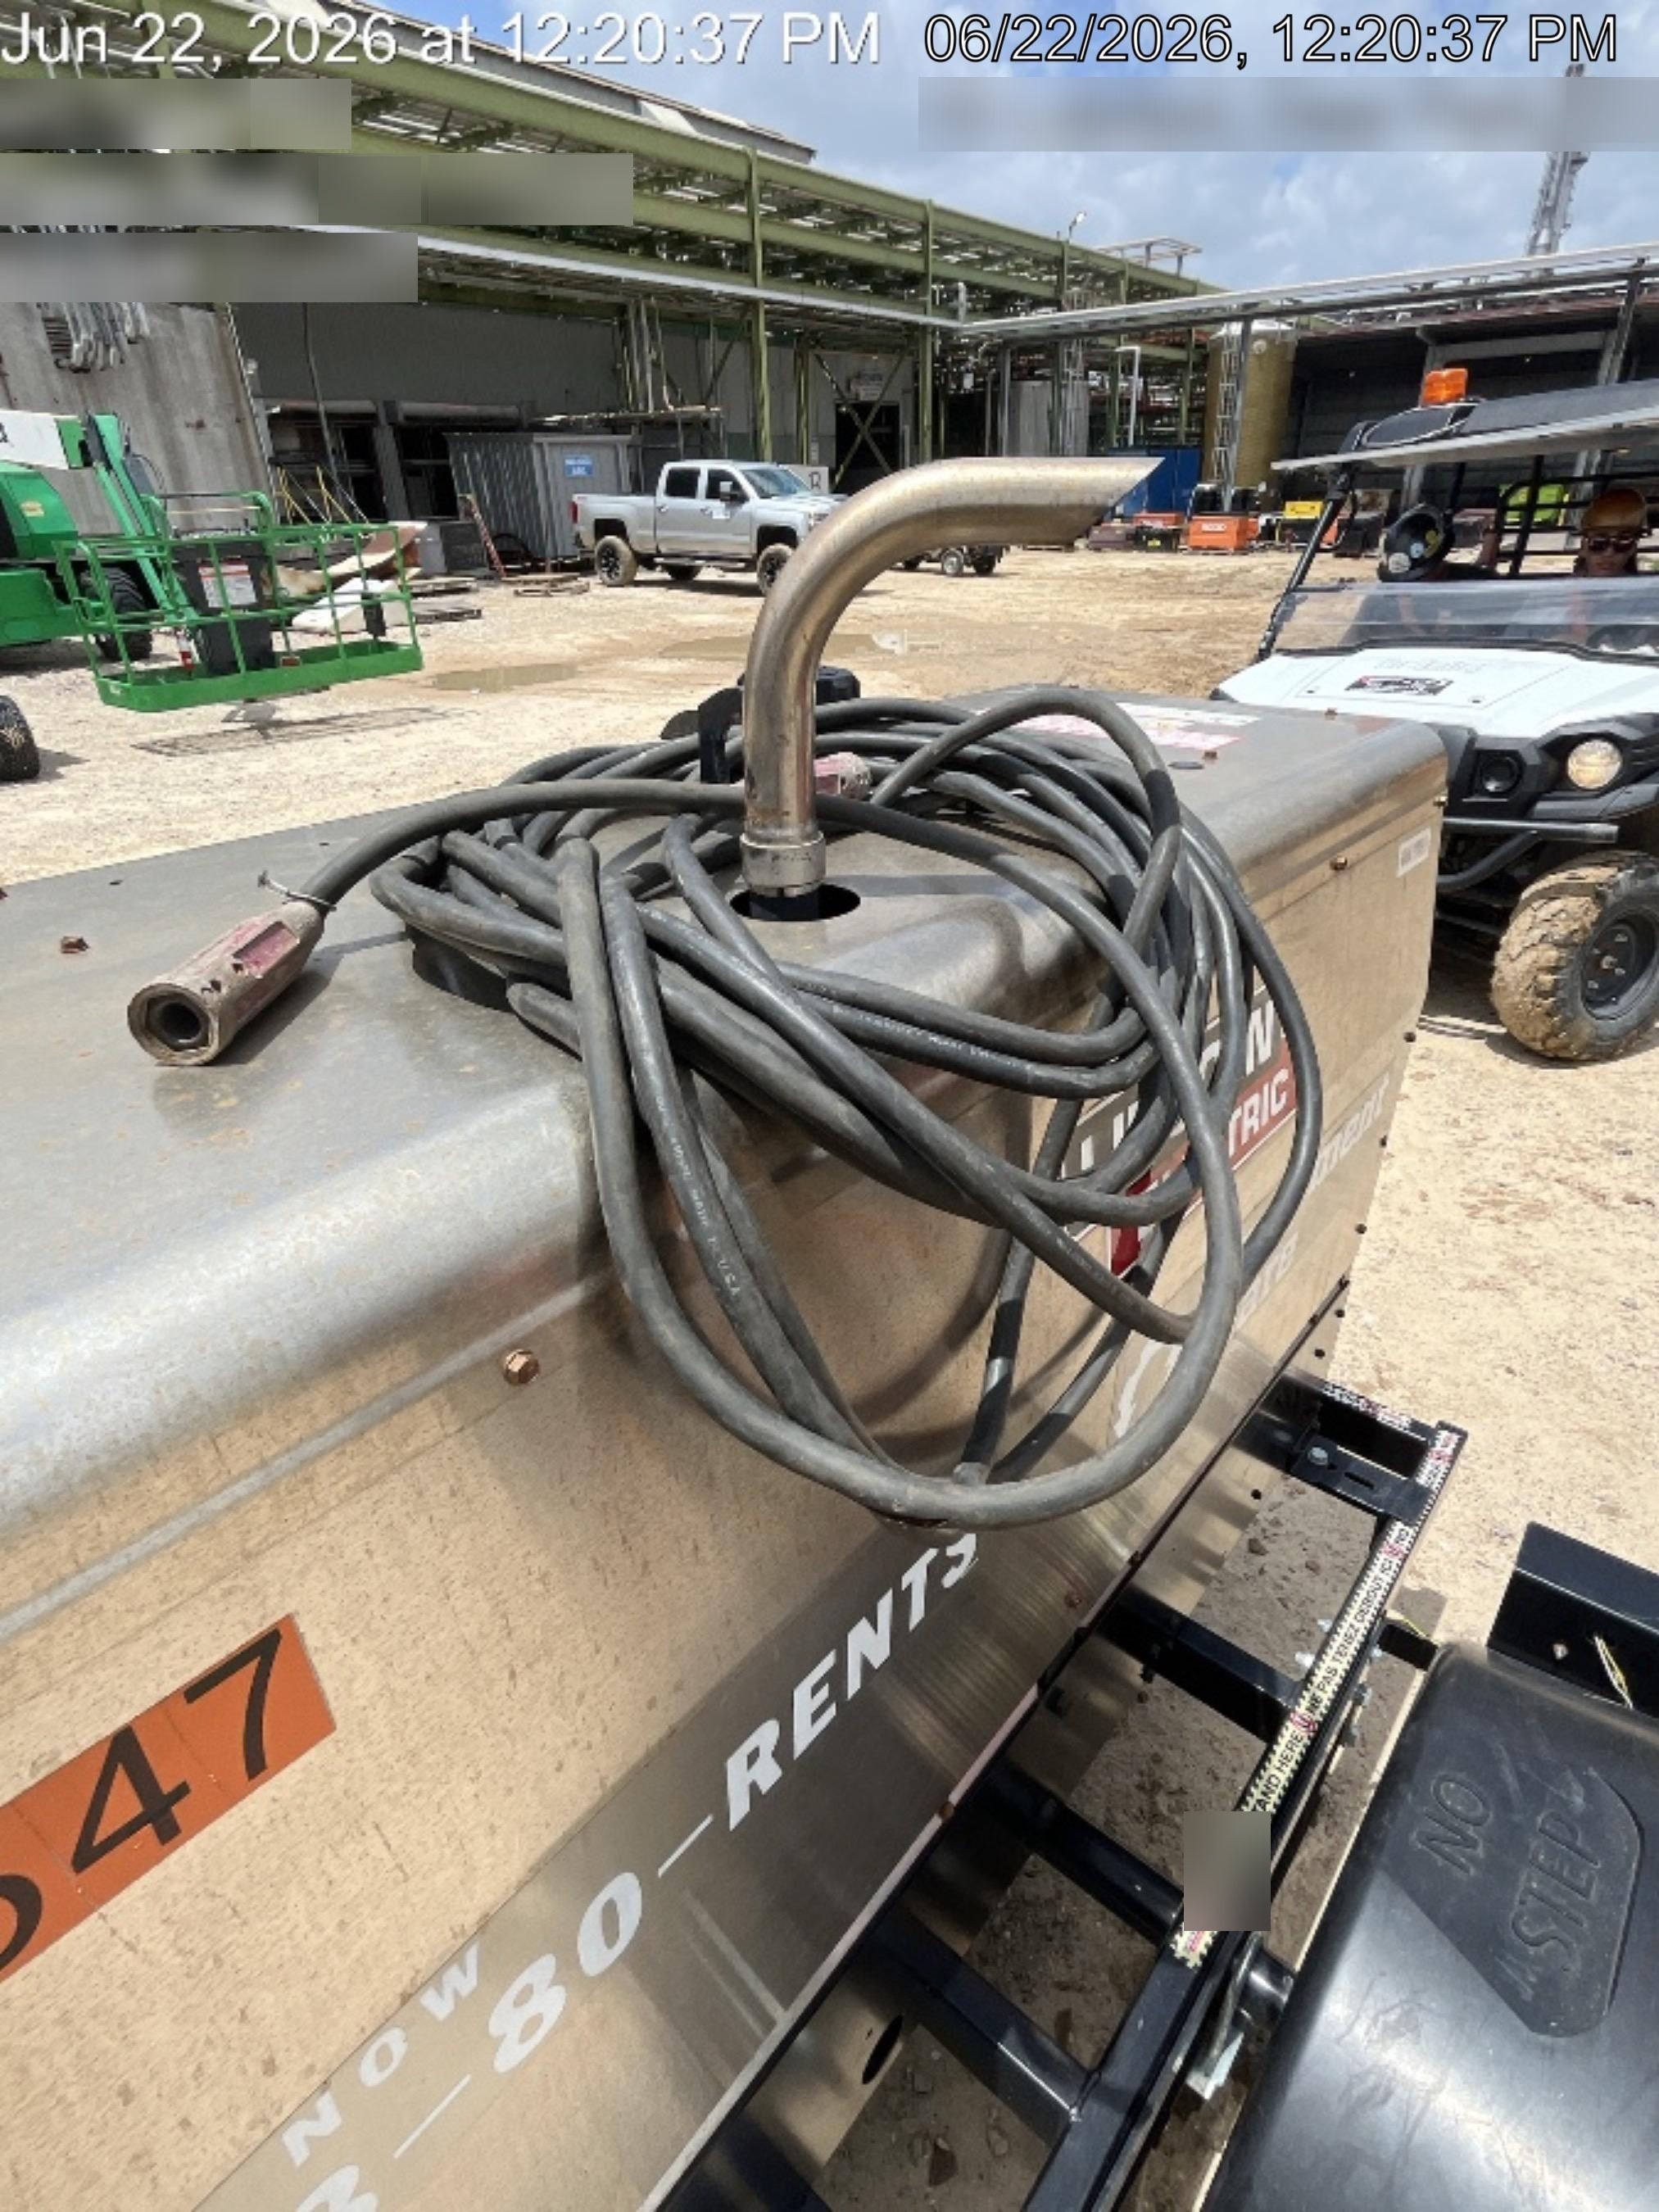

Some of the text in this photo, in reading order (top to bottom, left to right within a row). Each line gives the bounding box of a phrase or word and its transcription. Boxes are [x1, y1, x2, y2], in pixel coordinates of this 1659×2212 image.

[1276, 1729, 1304, 1772] HERE
[1317, 1666, 1338, 1694] PAS
[1413, 1773, 1493, 1878] NO
[1511, 1809, 1602, 1974] STEP
[282, 1941, 478, 2168] NOW
